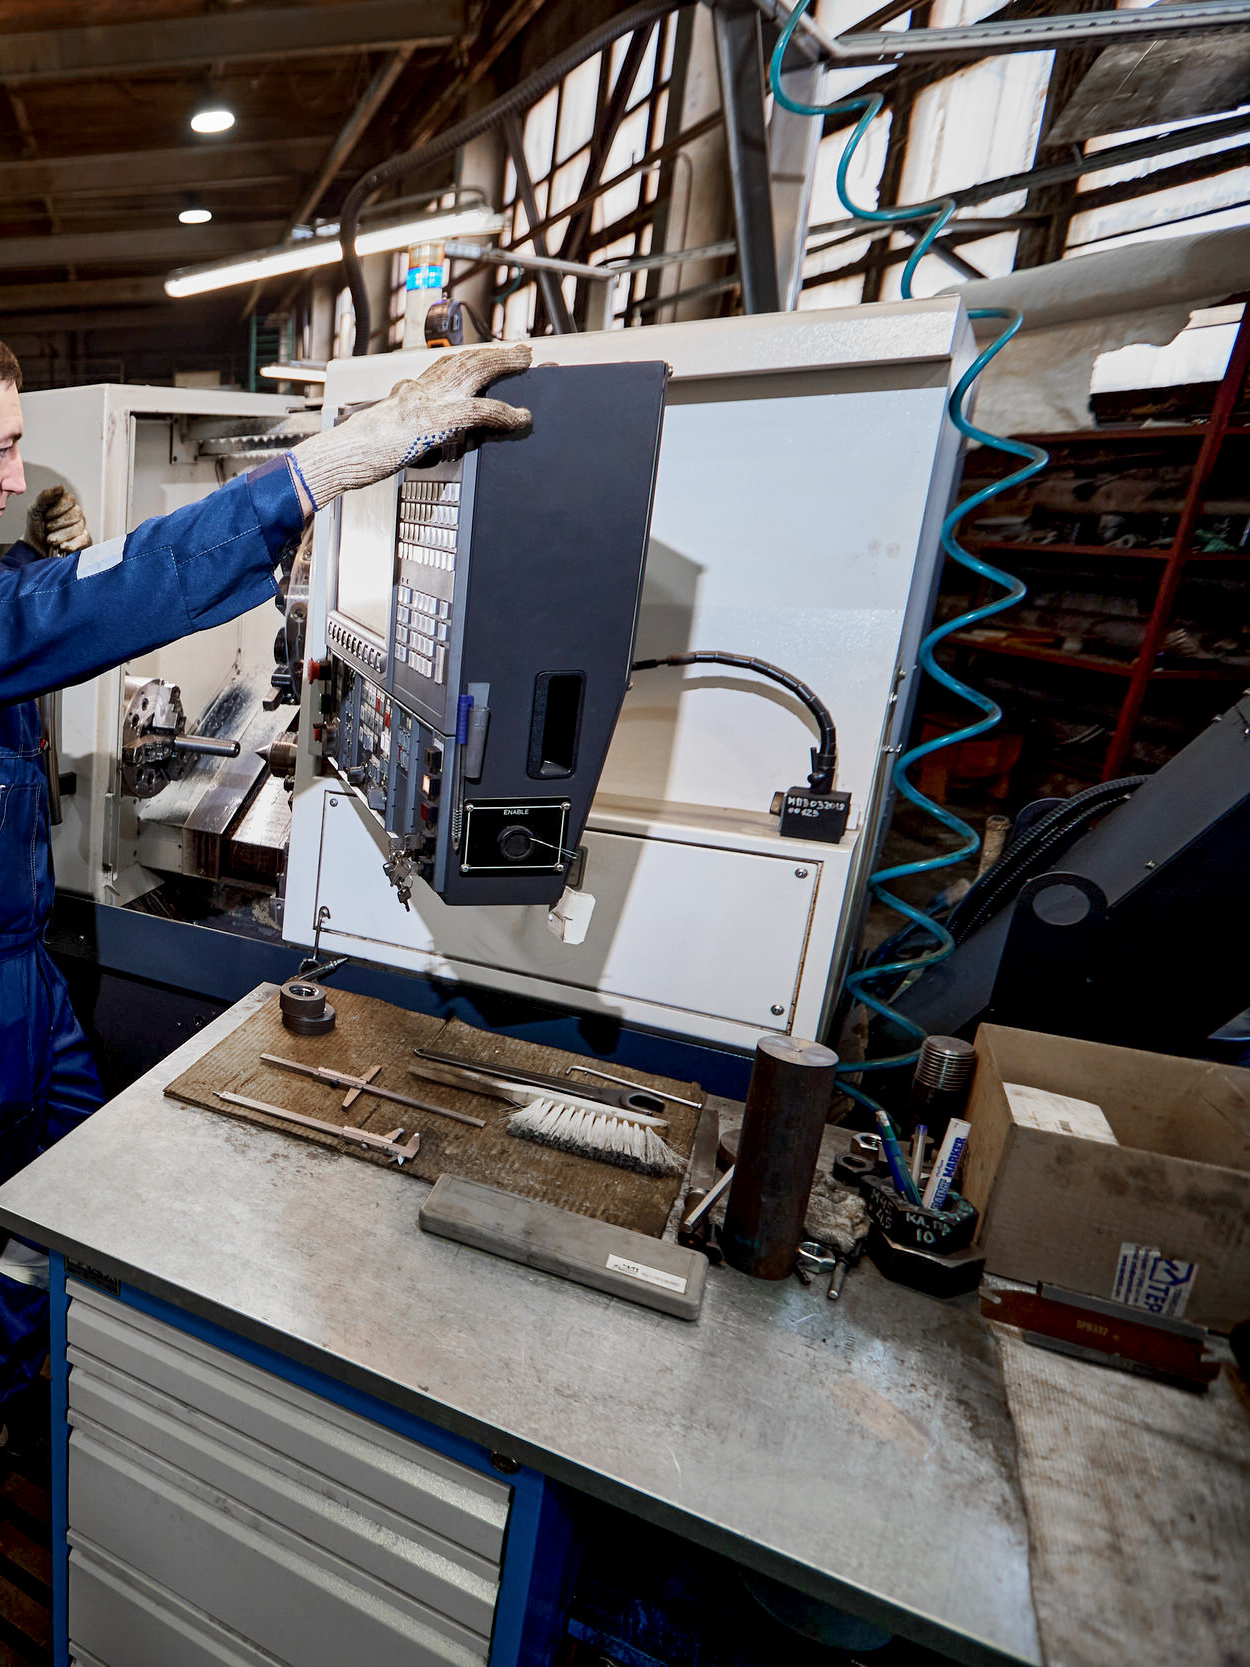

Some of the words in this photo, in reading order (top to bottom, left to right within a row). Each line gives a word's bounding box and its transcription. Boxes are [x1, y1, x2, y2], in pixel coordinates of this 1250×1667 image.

[503, 808, 529, 816] ENABLE
[942, 1137, 967, 1178] MARKER
[916, 1228, 936, 1244] 10
